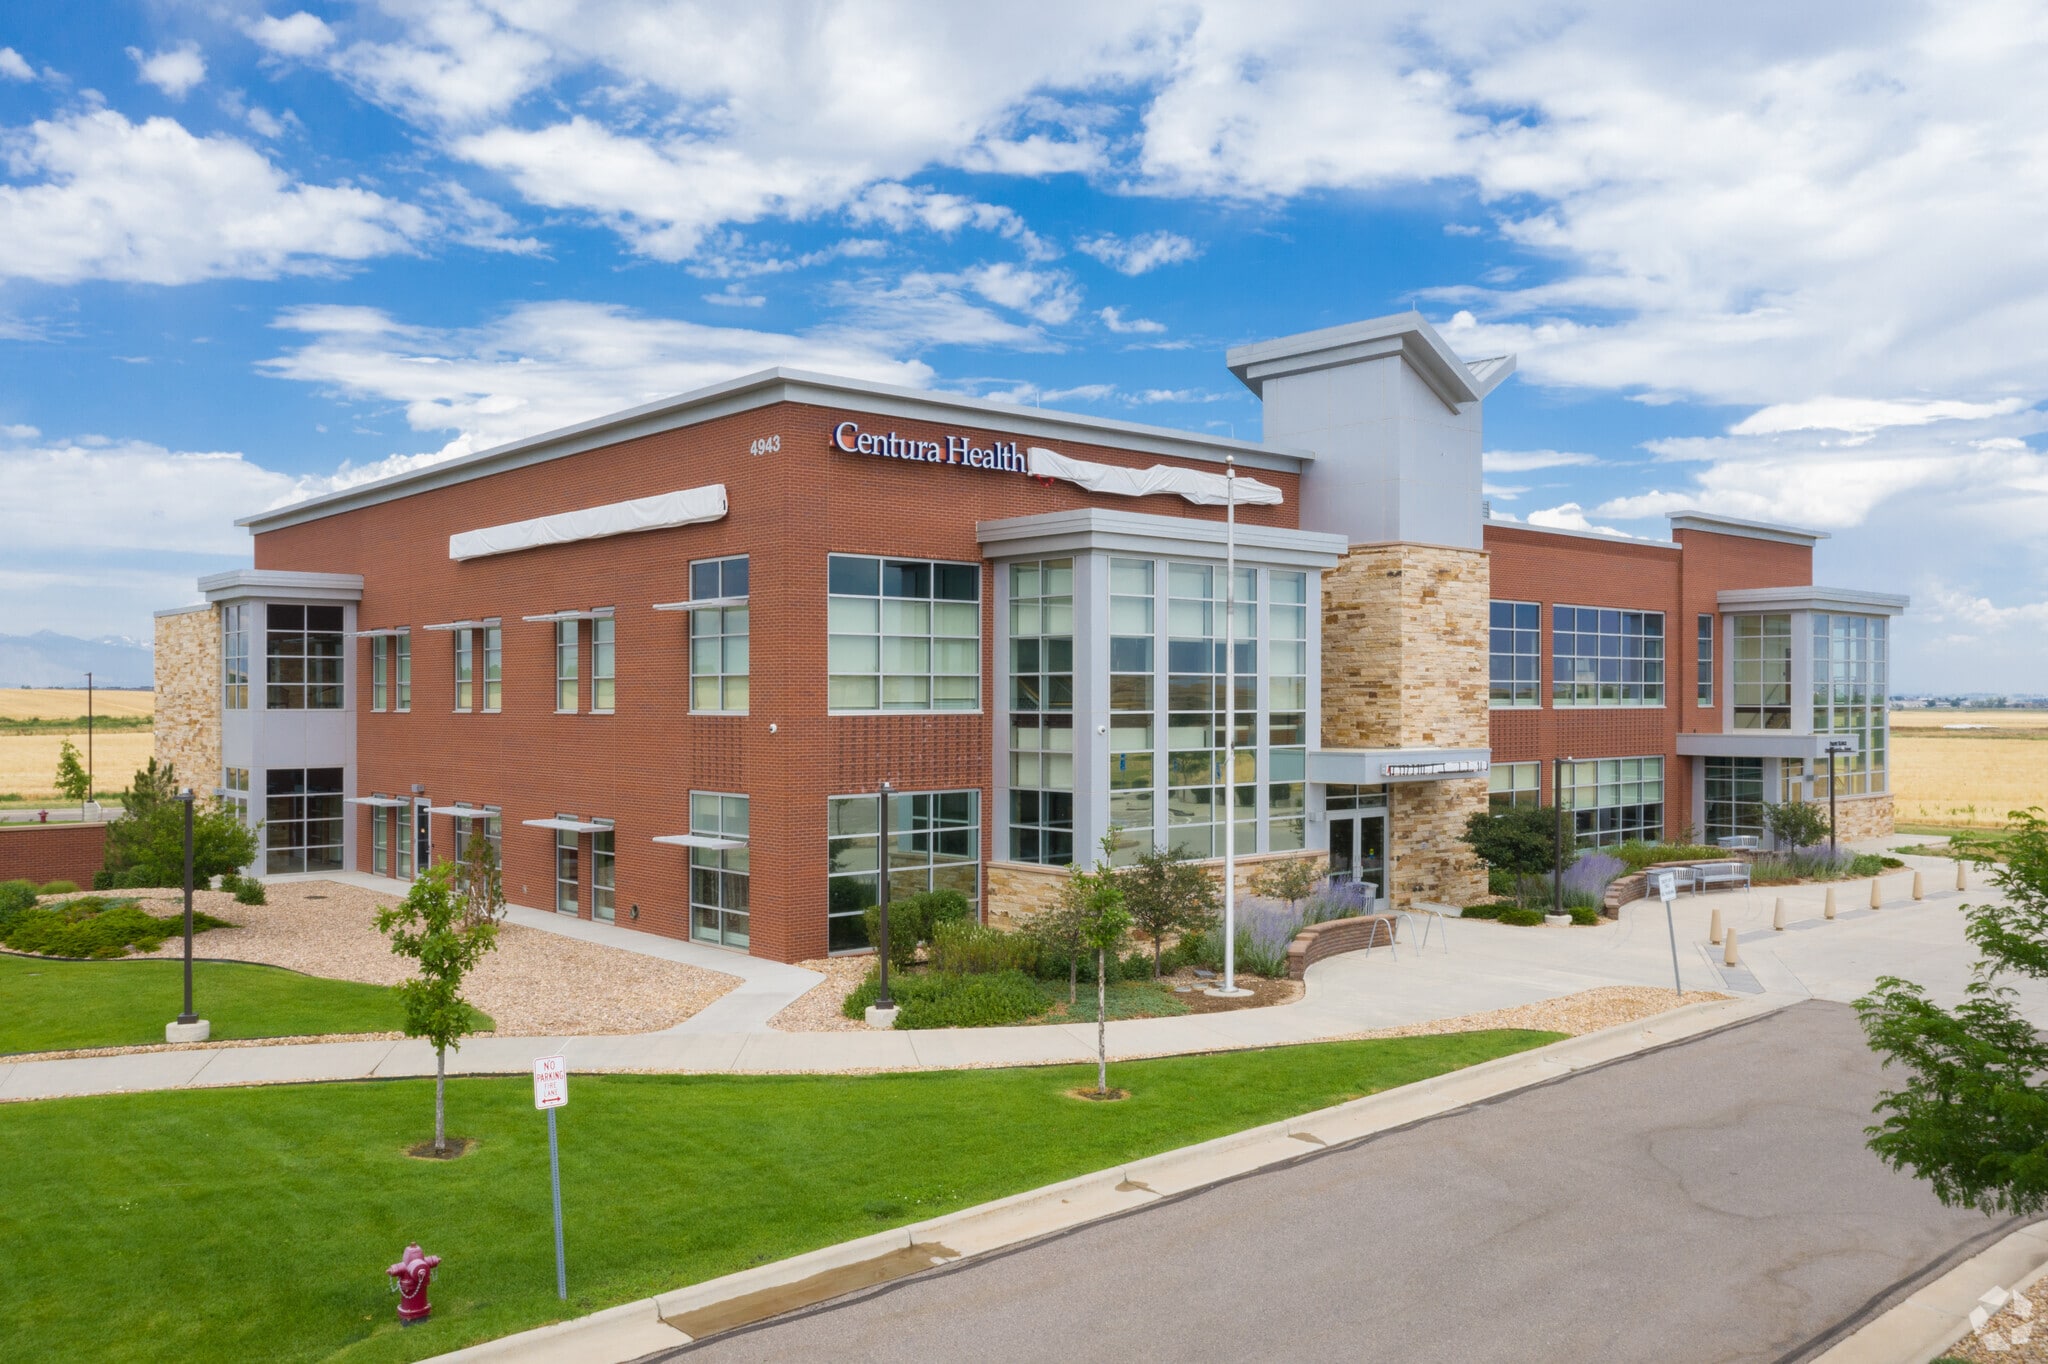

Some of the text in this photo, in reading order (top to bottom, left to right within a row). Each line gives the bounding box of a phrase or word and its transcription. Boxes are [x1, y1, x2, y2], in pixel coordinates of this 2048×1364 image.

[750, 435, 781, 456] 4943
[834, 421, 1027, 473] Centura Health
[543, 1061, 555, 1070] NO
[536, 1070, 564, 1081] PARKING
